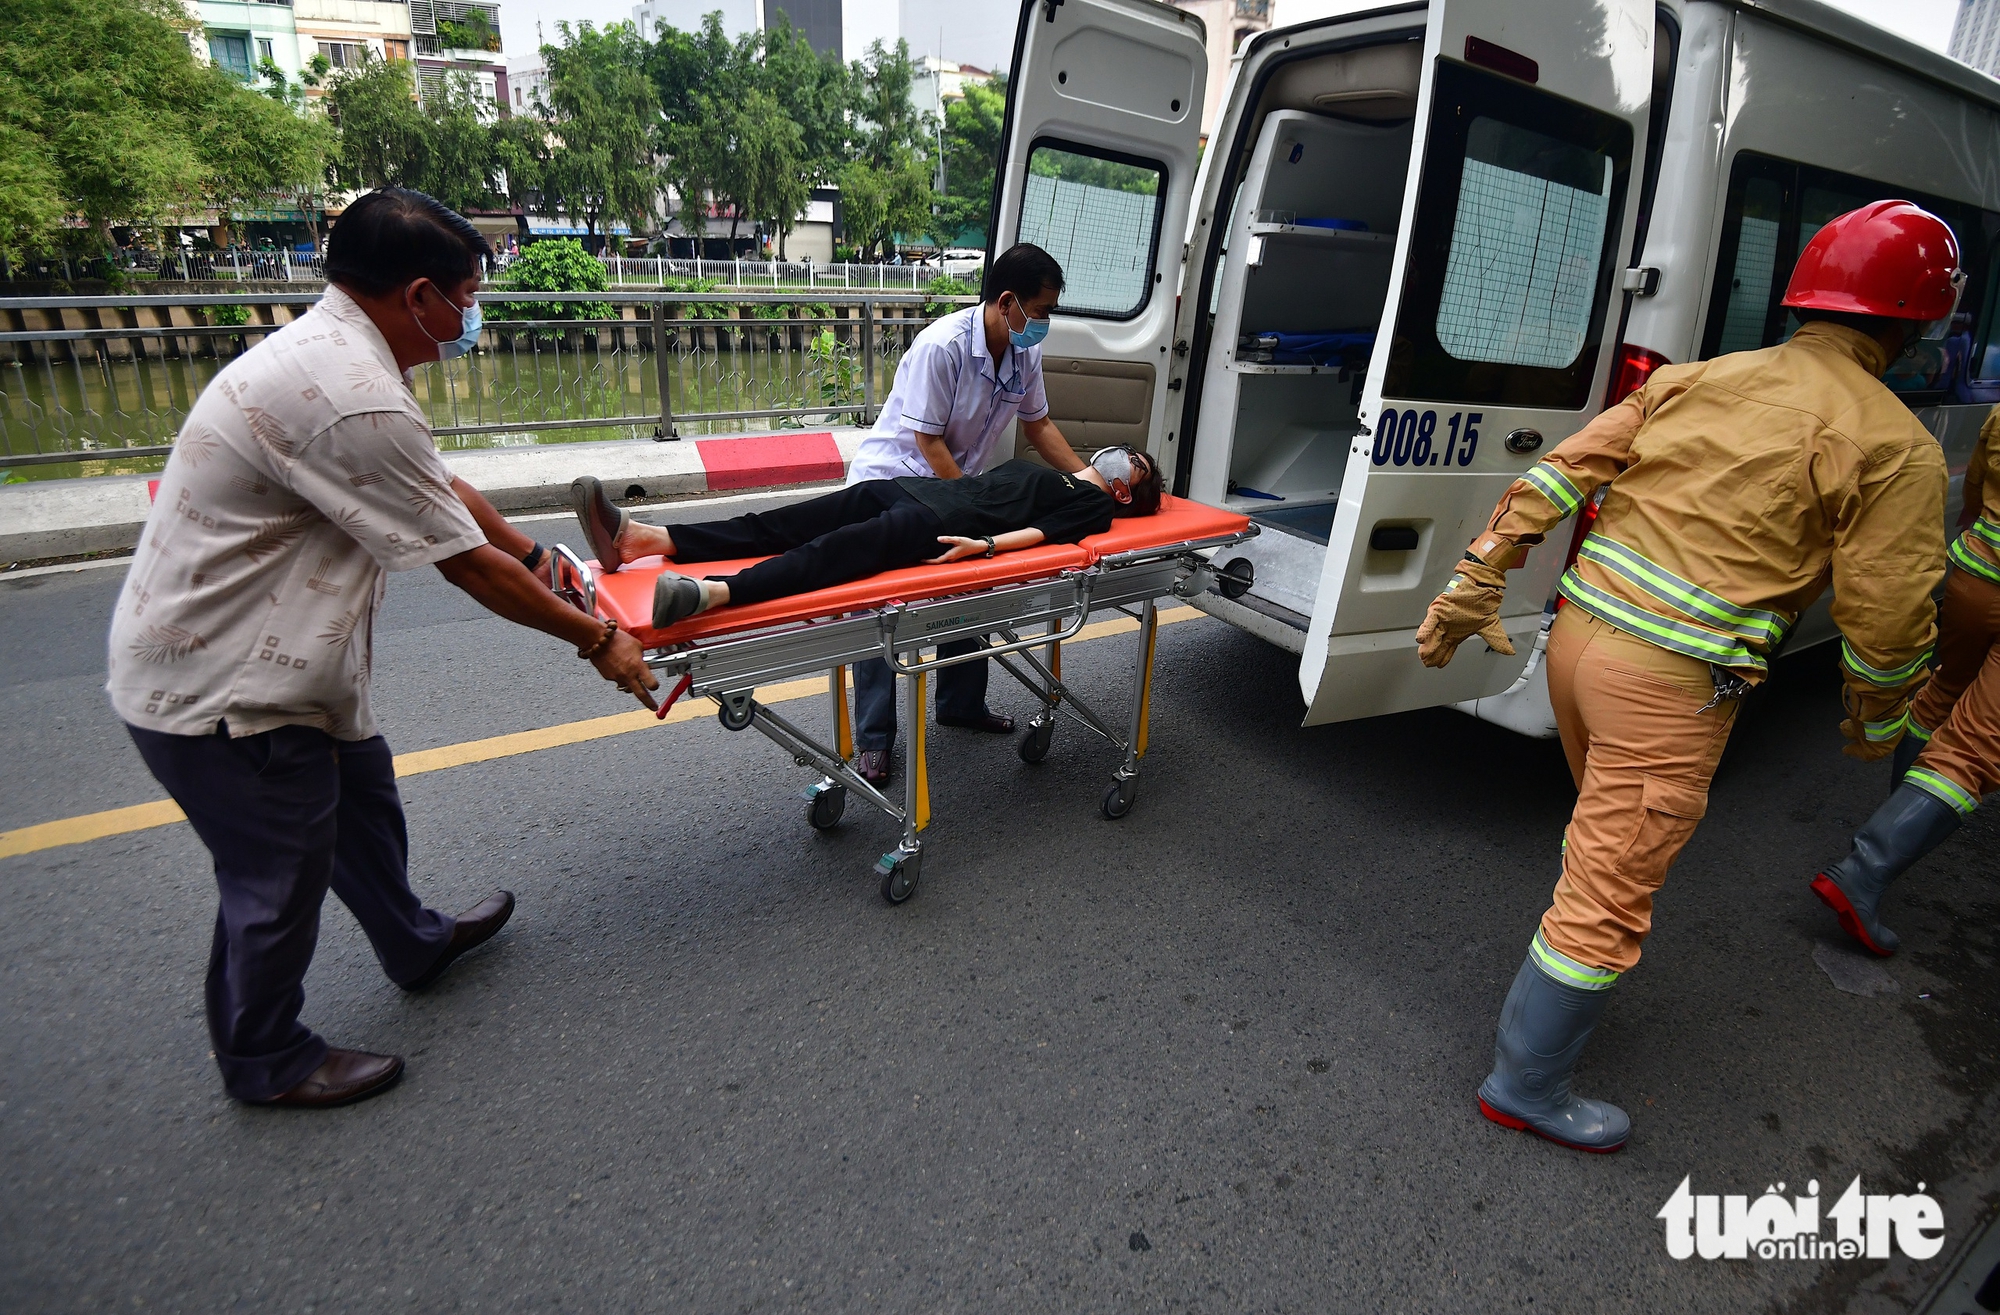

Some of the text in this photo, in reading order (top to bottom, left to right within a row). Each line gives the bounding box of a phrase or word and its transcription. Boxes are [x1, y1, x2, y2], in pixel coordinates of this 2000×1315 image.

[1371, 408, 1483, 467] 008.15
[1516, 434, 1539, 448] Ford
[925, 617, 960, 631] SAIKANG
